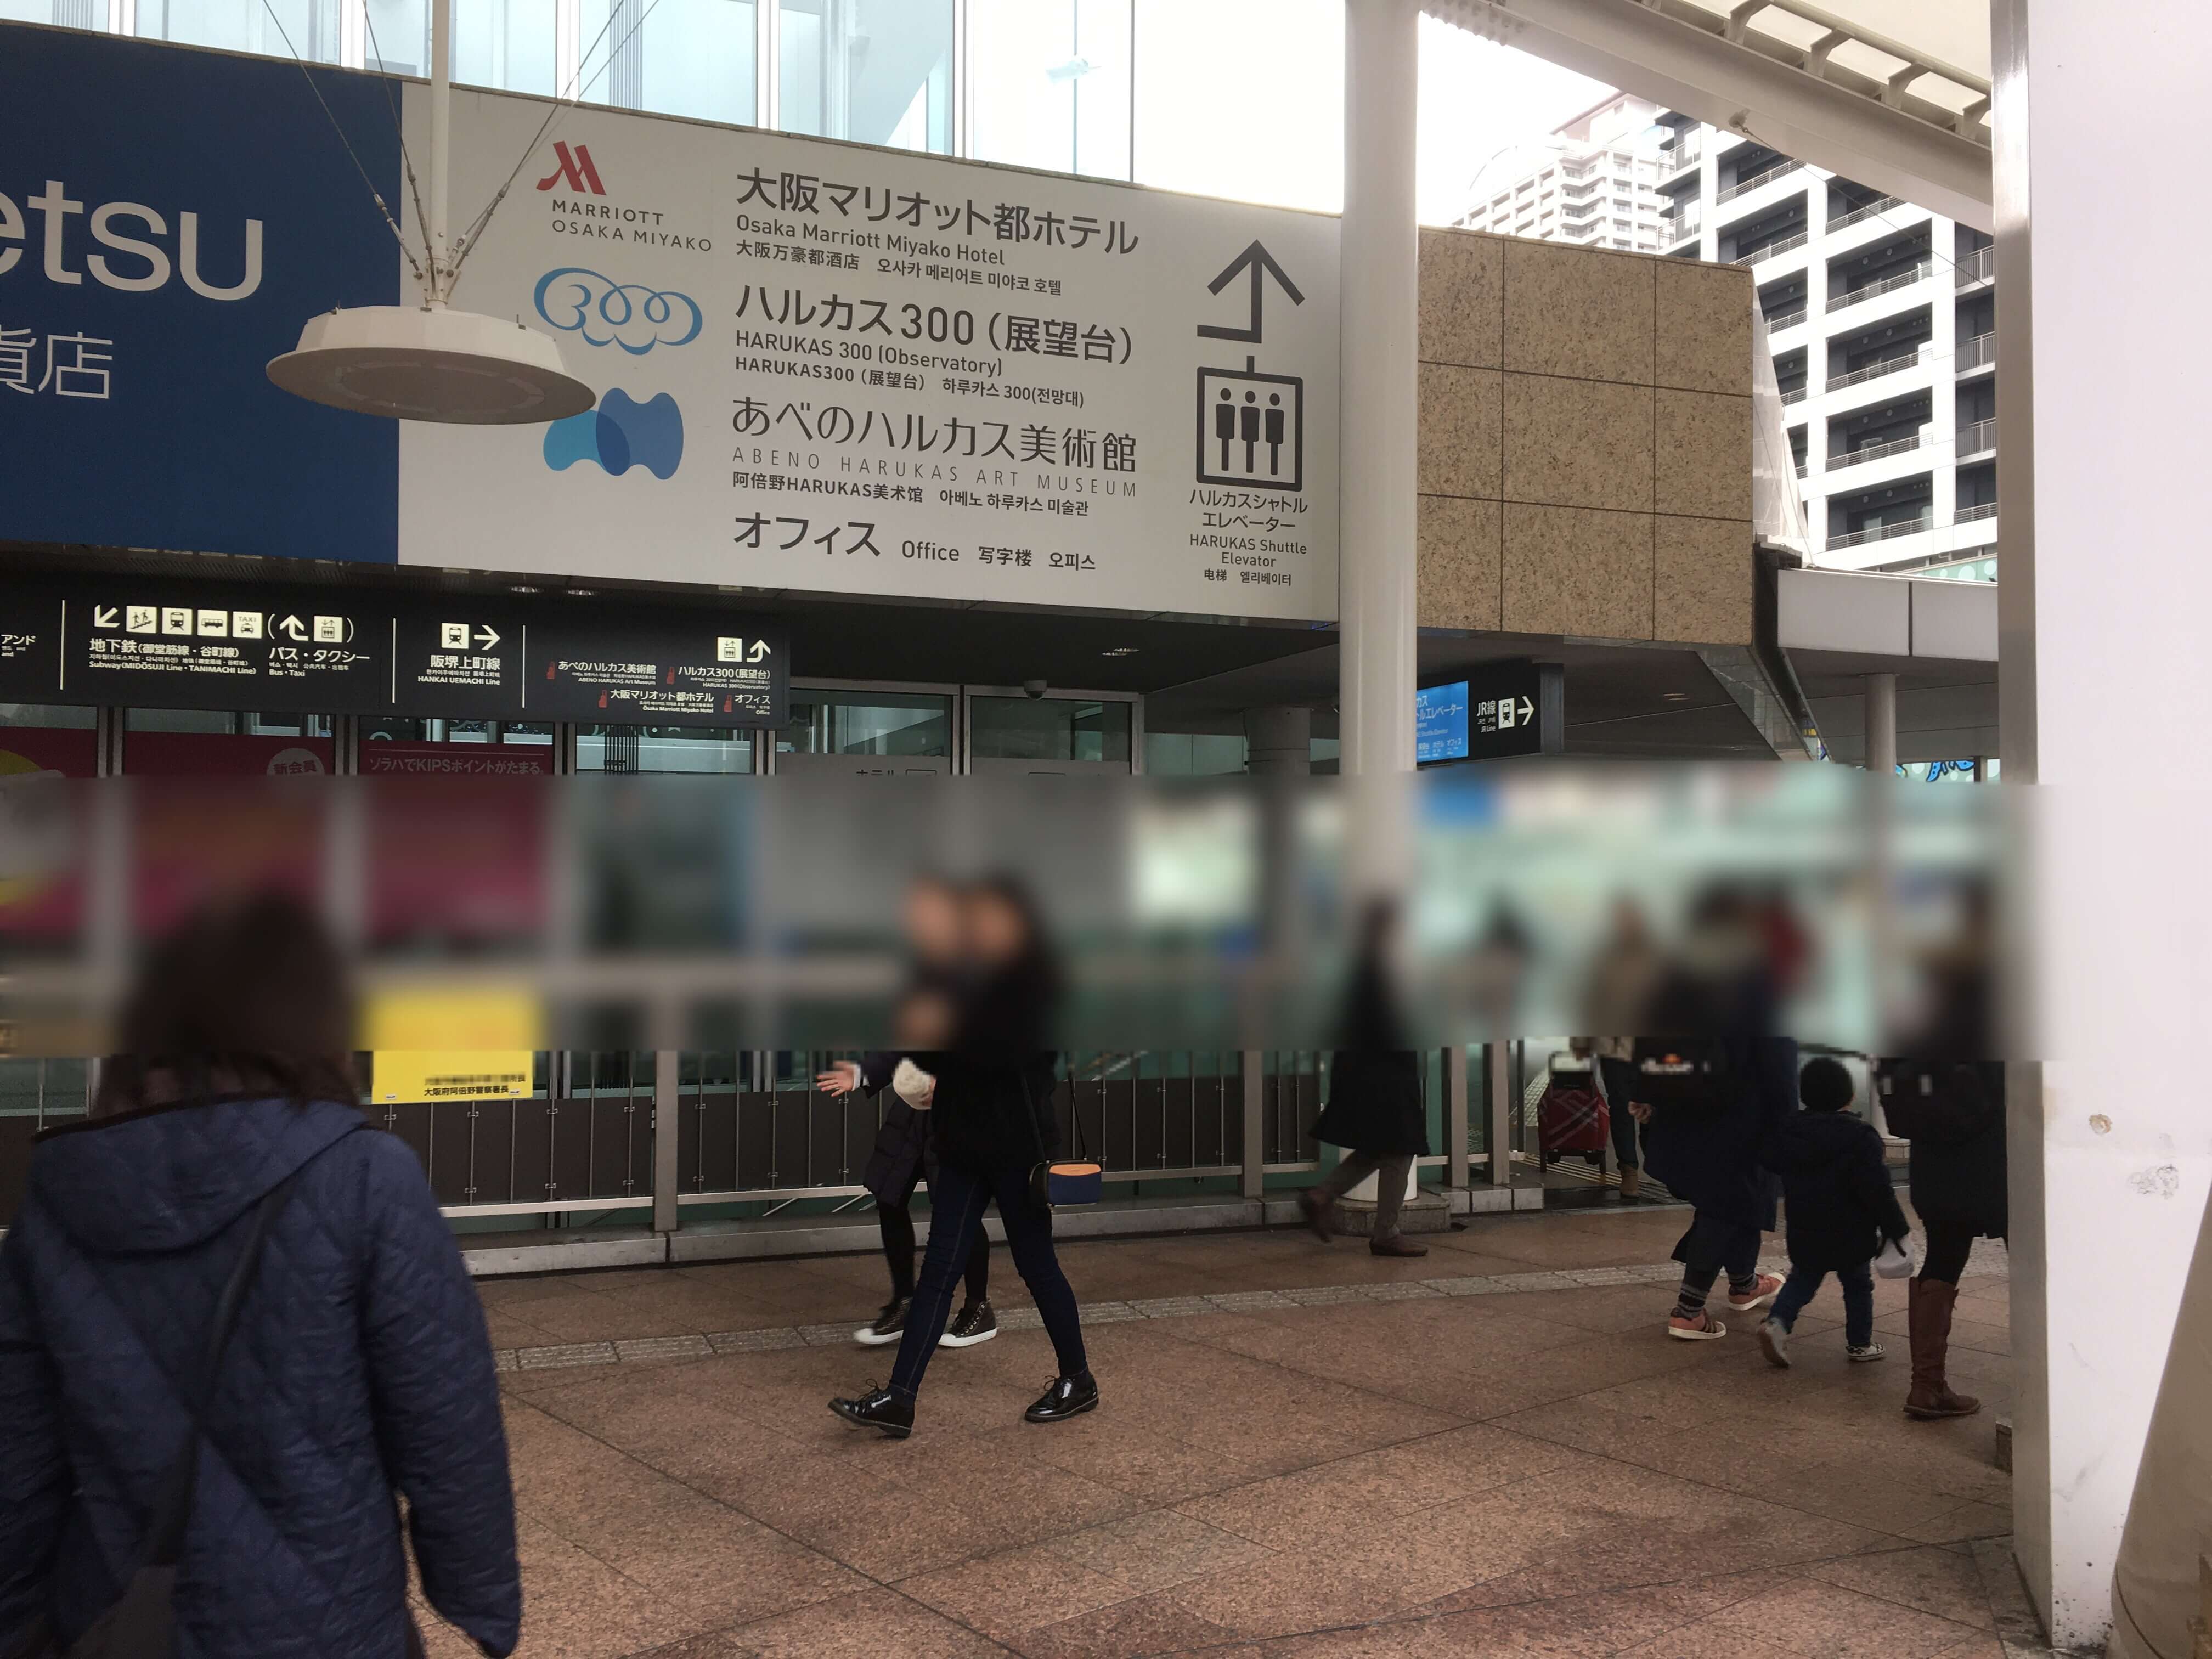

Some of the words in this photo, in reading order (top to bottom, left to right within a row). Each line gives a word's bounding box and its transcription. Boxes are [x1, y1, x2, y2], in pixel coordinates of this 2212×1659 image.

[552, 200, 663, 225] MARRIOTT
[737, 167, 1139, 255] 大阪マリオット都ホテル
[552, 220, 623, 240] OSAKA
[634, 230, 712, 251] MIYAKO
[737, 215, 795, 238] Osaka
[803, 223, 880, 249] Marriott
[887, 234, 950, 258] Miyako
[957, 244, 1005, 265] Hotel
[736, 240, 860, 270] 大阪万豪都酒店
[877, 258, 921, 278] 오사카
[926, 264, 983, 285] 메리어트
[988, 272, 1030, 291] 미야코
[1034, 278, 1061, 296] 호텔
[737, 330, 832, 356] HARUKAS
[839, 342, 871, 360] 300
[879, 345, 1001, 378] (Observatory)
[943, 378, 999, 397] 하루카스
[1004, 386, 1084, 408] 300(전망대)
[733, 396, 1136, 473] あべのハルカス美術館
[733, 447, 819, 469] ABENO
[841, 456, 957, 481] HARUKAS
[976, 470, 1018, 486] ART
[1037, 475, 1136, 497] MUSEUM
[733, 471, 923, 503] 阿倍野HARUKAS美术馆
[940, 490, 983, 507] 아베노
[987, 493, 1043, 511] 하루카스
[1048, 499, 1088, 516] 미술관
[1190, 489, 1308, 513] ハルカスシャトル
[1203, 512, 1295, 532] エレベーター
[734, 512, 880, 557] オフィス
[1190, 534, 1256, 550] HARUKAS
[1260, 539, 1307, 554] Shuttle
[902, 540, 960, 562] Office
[978, 546, 1032, 566] 写字楼
[1048, 552, 1096, 571] 오피스
[1222, 552, 1277, 567] Elevator
[1204, 568, 1227, 582] 电梯
[1240, 571, 1291, 586] 엘리베이터
[1, 634, 36, 645] アンド
[431, 654, 500, 670] 阪堺上町線
[558, 661, 656, 674] あべのハルカス美術館
[610, 689, 714, 702] 大阪マリオット都ホテル
[735, 694, 770, 704] オフィス
[1477, 700, 1496, 716] JR線
